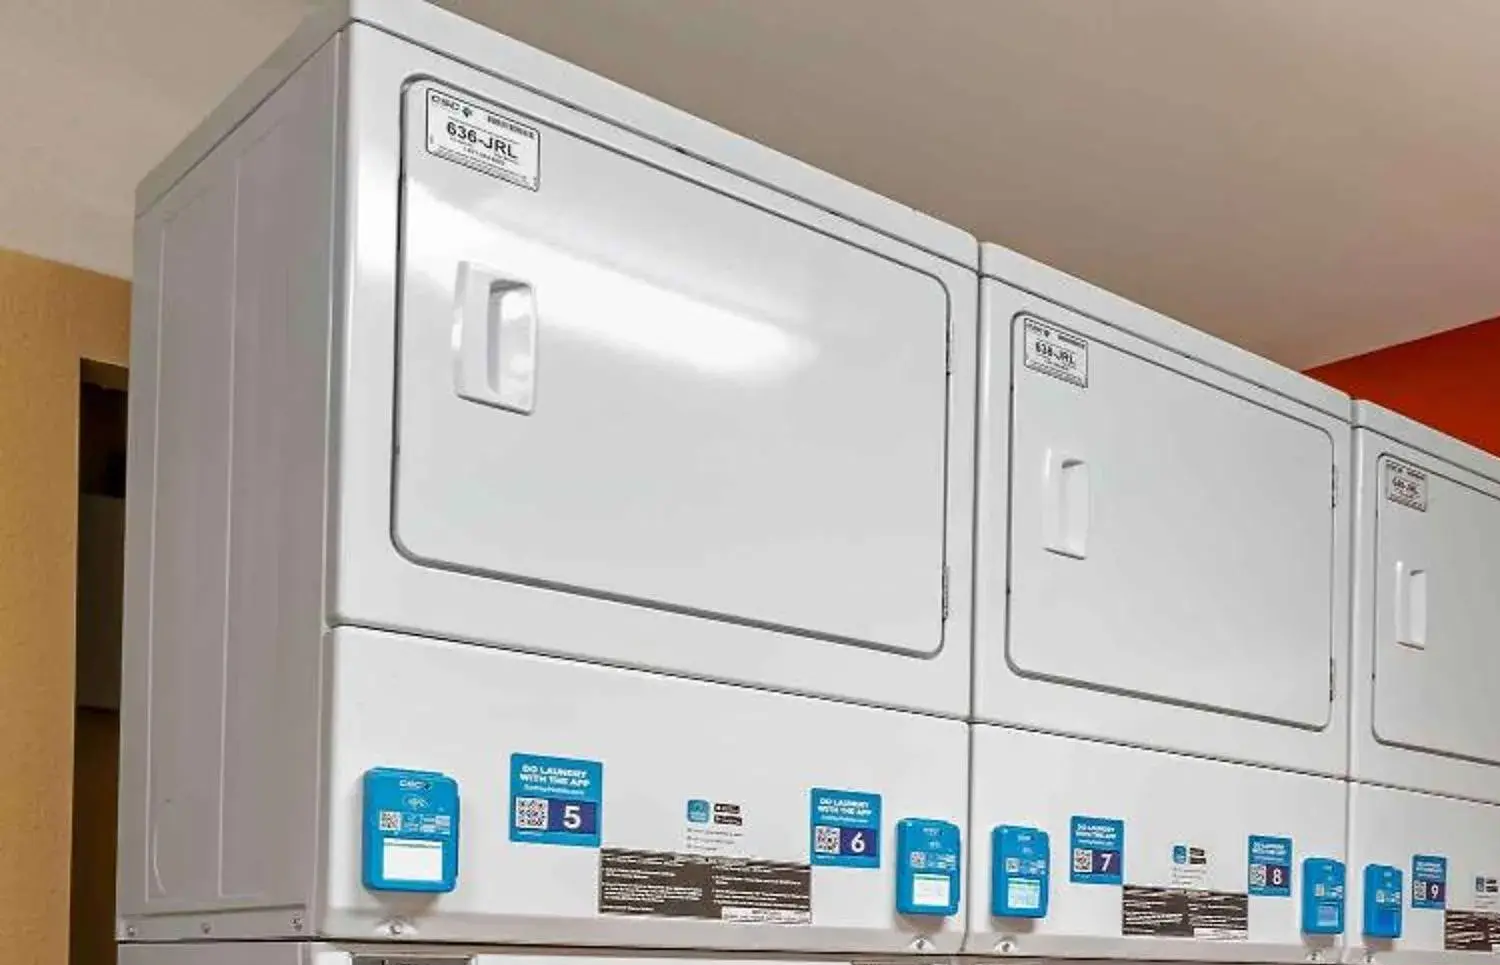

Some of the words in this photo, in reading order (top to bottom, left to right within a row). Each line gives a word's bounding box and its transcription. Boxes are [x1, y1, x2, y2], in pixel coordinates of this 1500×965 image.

[447, 121, 519, 159] 636-JRL
[563, 805, 581, 829] 5
[851, 832, 865, 853] 6
[1101, 853, 1113, 872] 7
[1273, 868, 1281, 885] 8
[1431, 884, 1439, 899] 9
